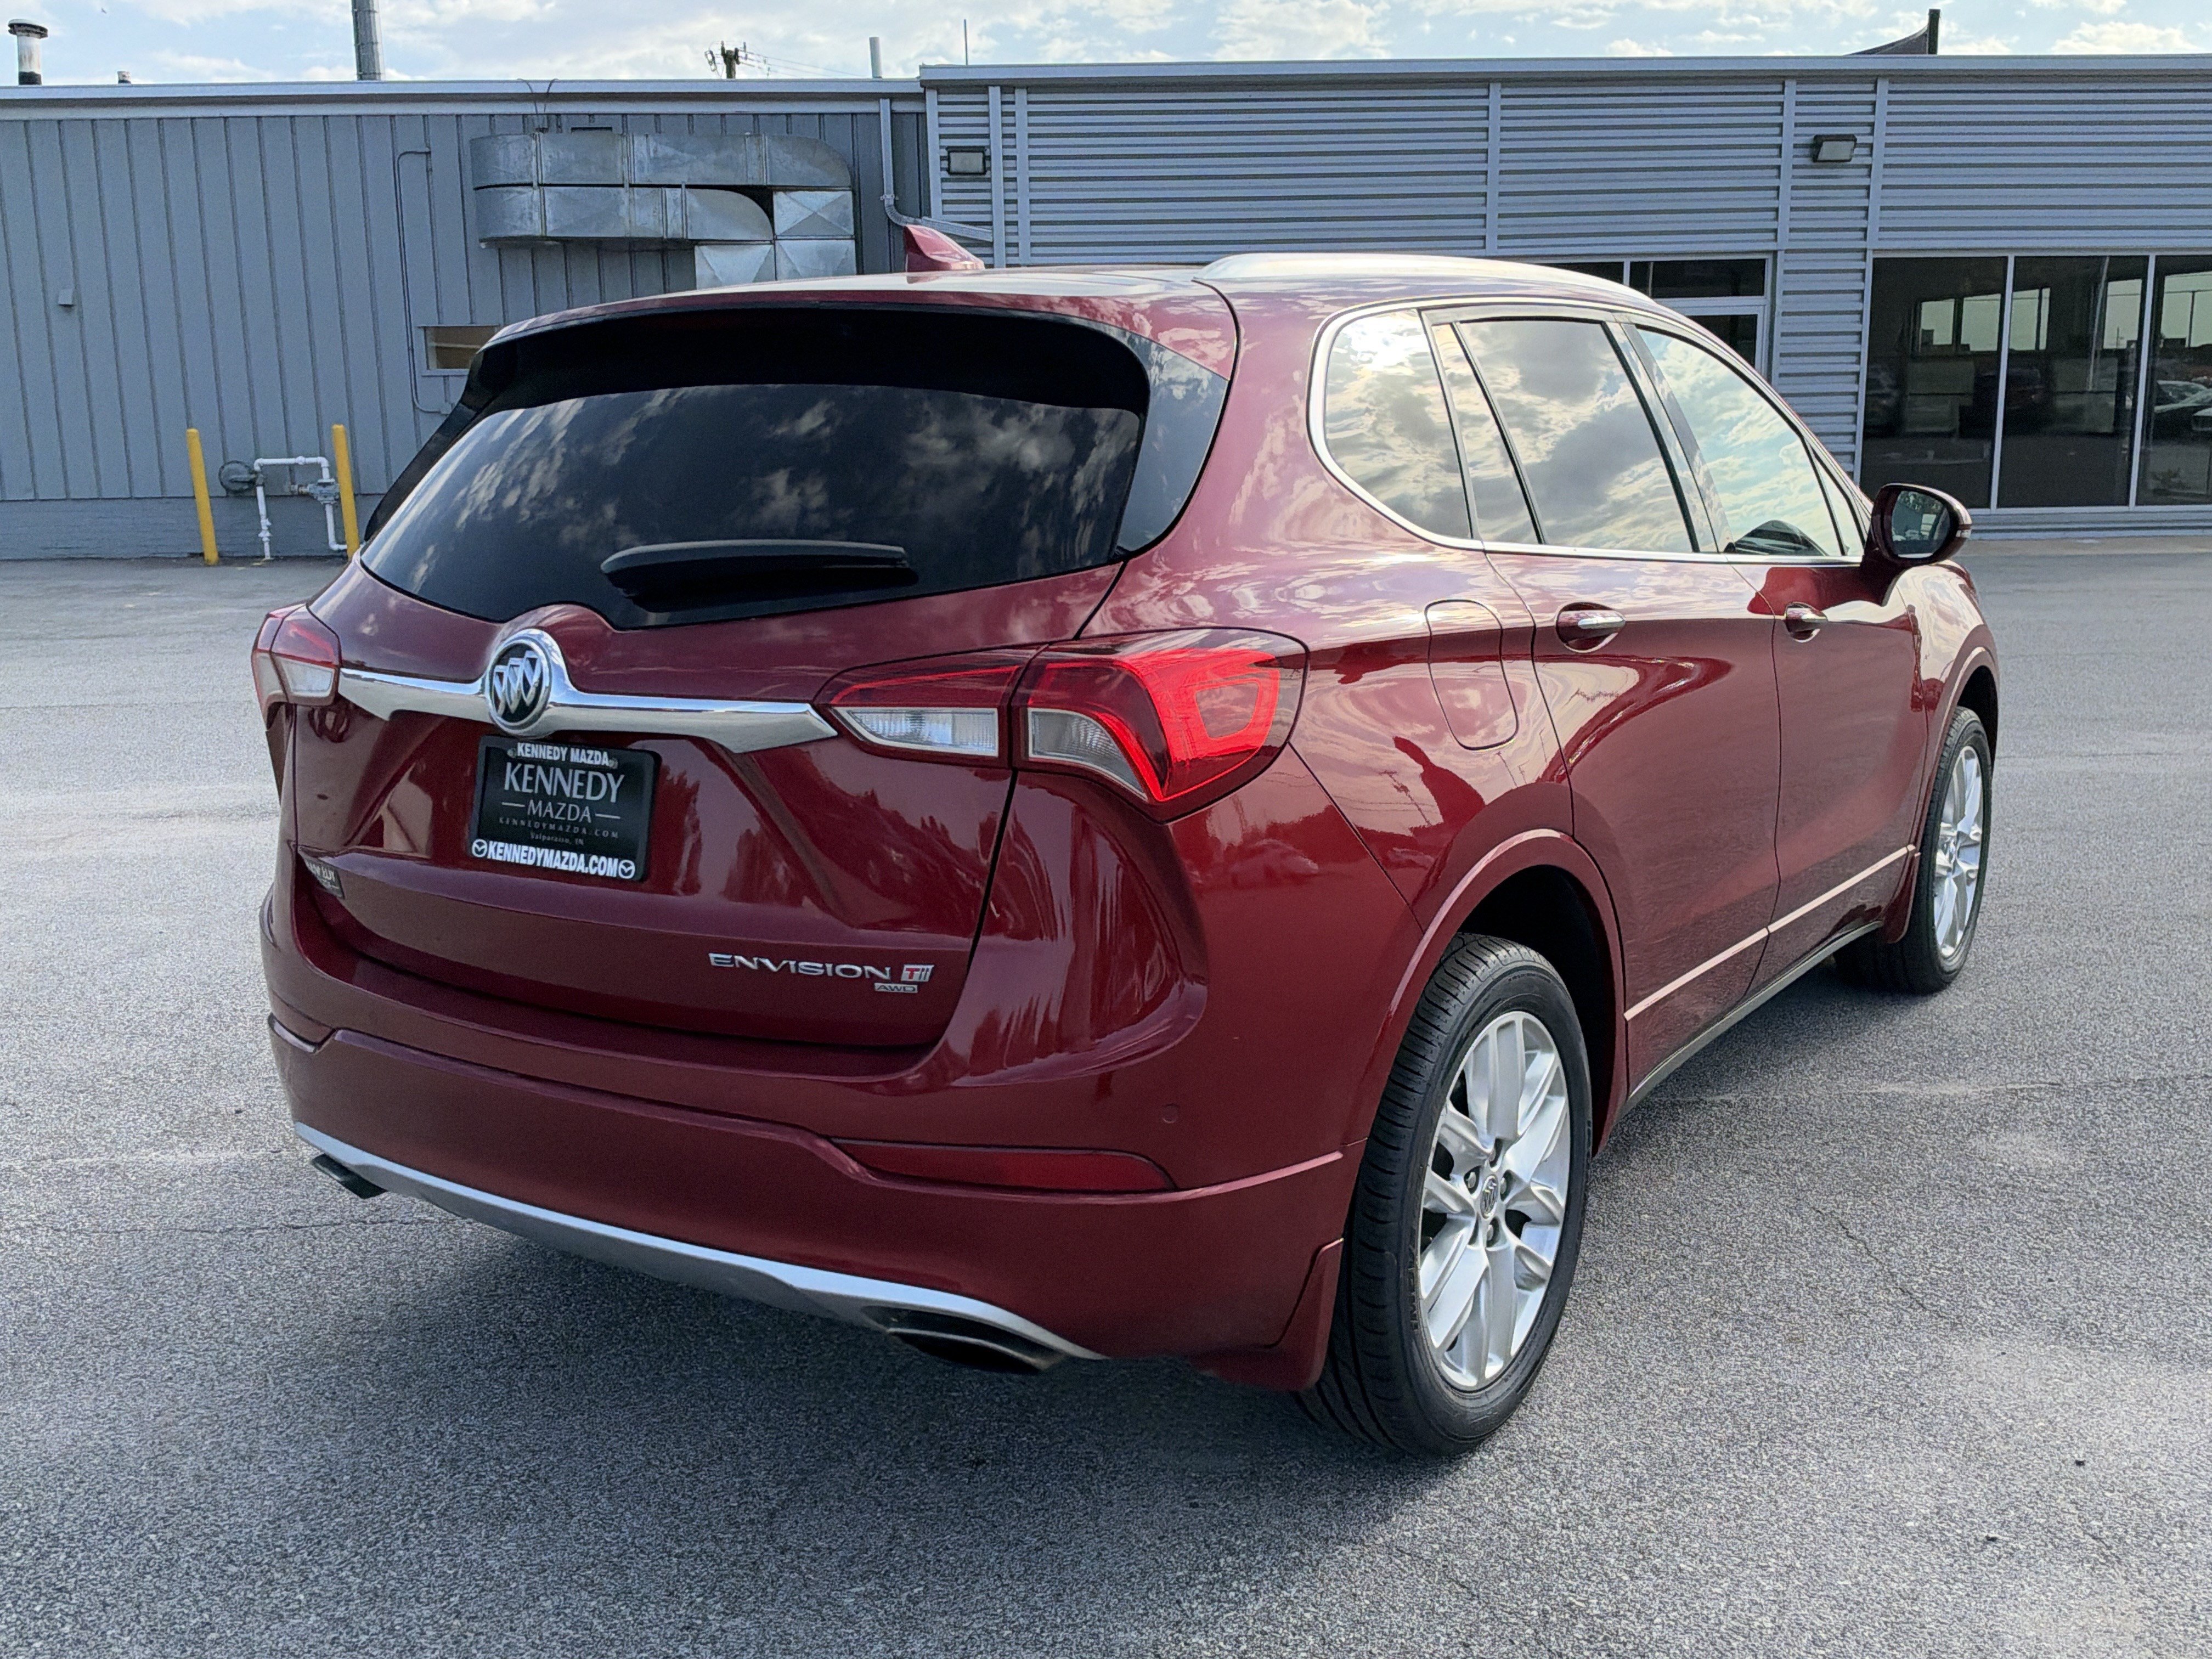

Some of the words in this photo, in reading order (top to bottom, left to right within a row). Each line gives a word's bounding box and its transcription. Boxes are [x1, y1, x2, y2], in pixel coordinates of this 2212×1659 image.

[517, 742, 568, 761] KENNEDY
[570, 748, 610, 766] MAZDA
[504, 762, 624, 803] KENNEDY
[527, 799, 592, 823] MAZDA
[487, 840, 619, 878] KENNEDYMAZDA.COM
[708, 952, 891, 980] ENVISION
[877, 984, 917, 992] AWD
